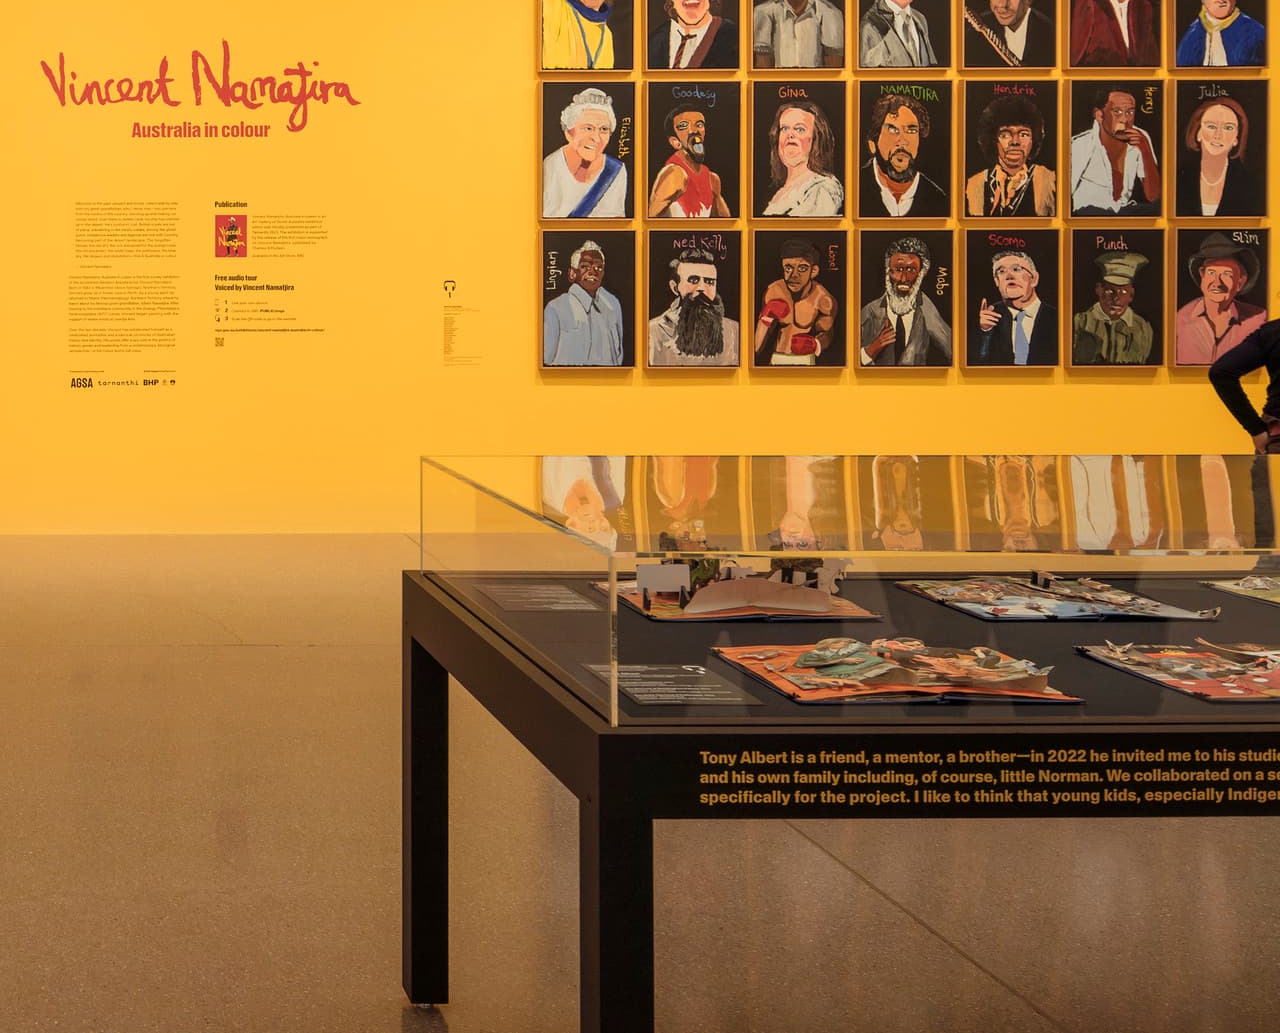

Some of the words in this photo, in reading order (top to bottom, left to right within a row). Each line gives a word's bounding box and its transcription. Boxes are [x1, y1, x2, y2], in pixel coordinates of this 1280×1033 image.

[40, 52, 181, 107] Vincent
[191, 38, 362, 133] Namatjira
[880, 85, 939, 102] NAMATJIRA
[993, 84, 1037, 96] Hendrix
[1198, 83, 1229, 100] Julia
[672, 85, 716, 108] Goodesy
[1141, 86, 1158, 114] Henry
[132, 122, 201, 138] Australia
[205, 122, 219, 138] in
[222, 121, 271, 138] colour
[1096, 235, 1129, 251] Punch
[235, 284, 242, 293] by
[266, 284, 295, 292] Namatjira
[936, 266, 949, 297] Mabo
[70, 377, 94, 388] AGSA
[700, 751, 737, 766] Tony
[740, 750, 788, 763] Albert
[791, 750, 804, 763] is
[808, 753, 817, 763] a
[820, 750, 870, 765] friend,
[873, 753, 882, 763] a
[886, 751, 944, 765] mentor,
[947, 753, 956, 762] a
[1048, 749, 1087, 762] 2022
[1090, 749, 1109, 762] he
[1113, 748, 1165, 761] invited
[1168, 751, 1192, 761] me
[1195, 749, 1210, 761] to
[1214, 748, 1236, 761] his
[700, 770, 729, 783] and
[732, 770, 755, 783] his
[758, 773, 791, 783] own
[793, 770, 841, 785] family
[844, 770, 919, 785] including,
[922, 770, 938, 783] of
[941, 772, 998, 784] course,
[1001, 769, 1036, 782] little
[1039, 769, 1104, 782] Norman.
[1107, 769, 1131, 781] We
[1134, 768, 1230, 781] collaborated
[1233, 771, 1252, 780] on
[1256, 770, 1265, 780] a
[700, 790, 791, 805] specifically
[795, 790, 817, 803] for
[820, 790, 846, 803] the
[850, 789, 911, 805] project.
[915, 790, 920, 802] I
[924, 789, 951, 802] like
[955, 790, 971, 802] to
[974, 789, 1014, 802] think
[1018, 789, 1049, 802] that
[1052, 791, 1101, 804] young
[1104, 788, 1141, 803] kids,
[1145, 787, 1225, 803] especially
